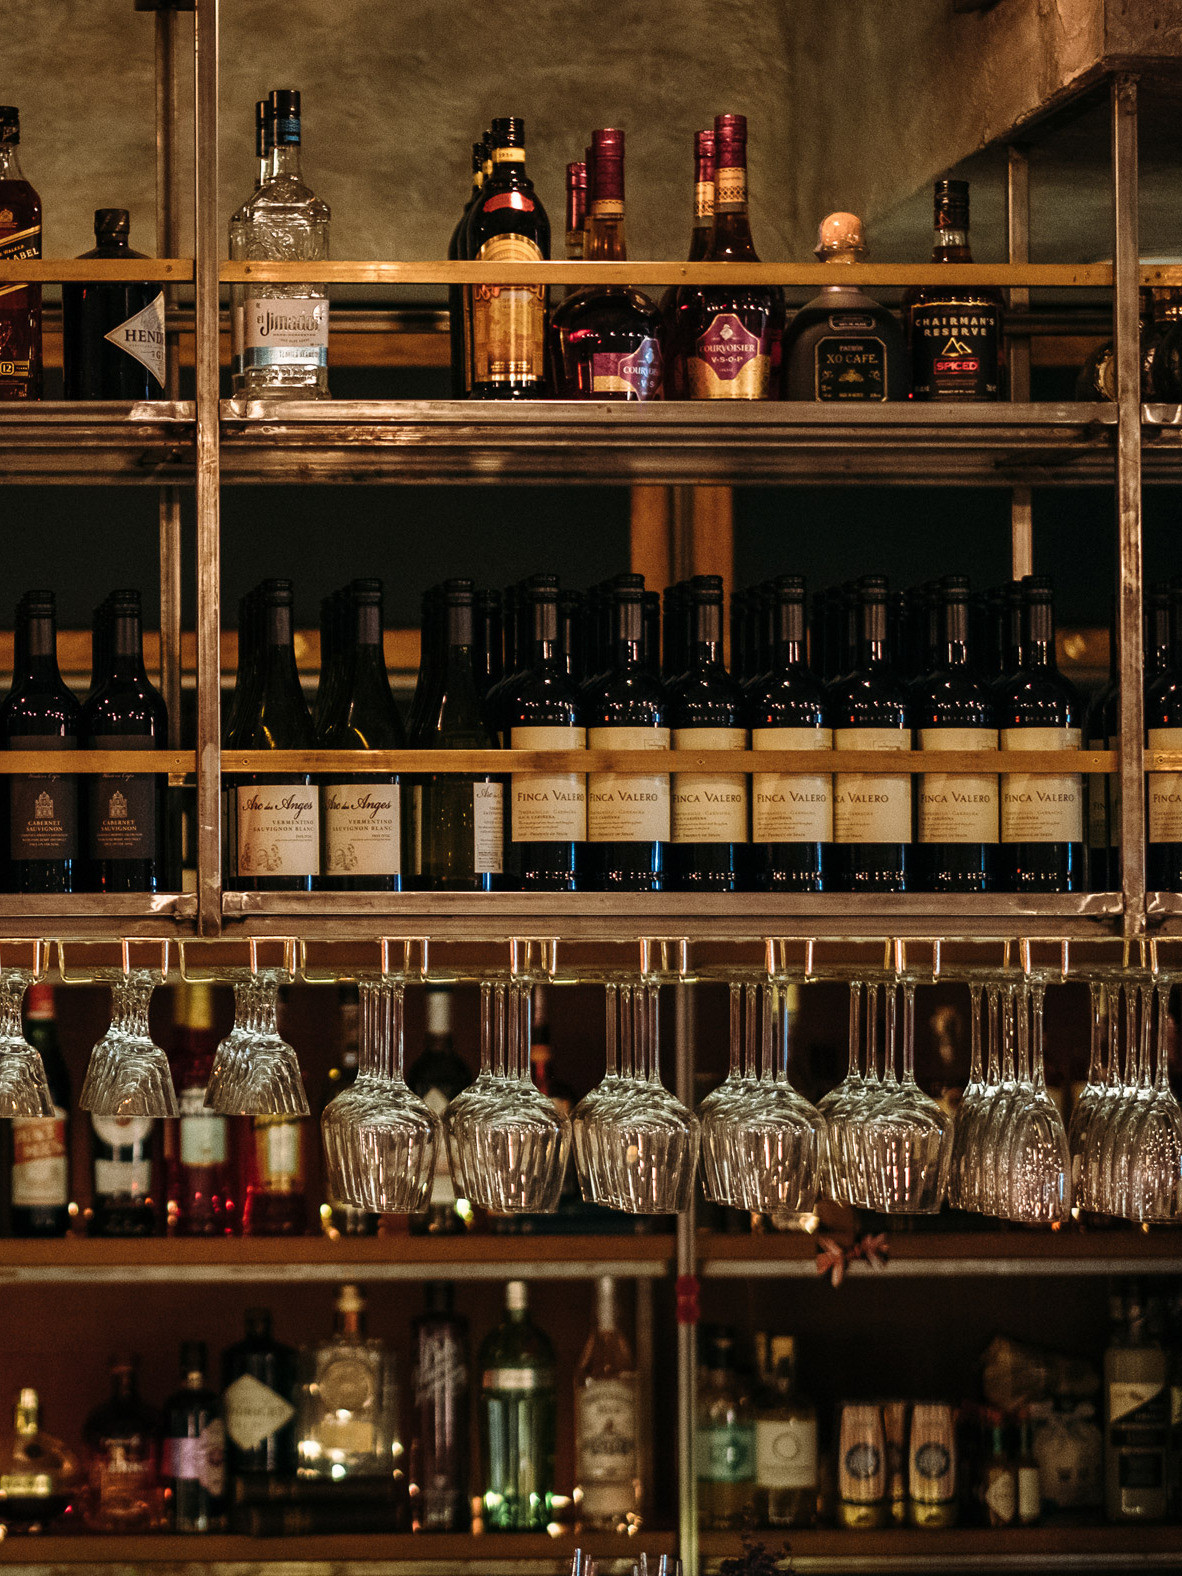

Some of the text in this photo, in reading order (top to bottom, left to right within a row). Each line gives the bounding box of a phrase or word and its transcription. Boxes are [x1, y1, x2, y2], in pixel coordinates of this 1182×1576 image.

[3, 245, 24, 254] WALKER
[257, 311, 320, 336] el Jimador
[915, 317, 995, 327] CHAIRMAN'S
[125, 330, 163, 345] HEND
[924, 328, 987, 337] RESERVE
[699, 344, 755, 355] COURVOISIER
[827, 354, 843, 364] XO
[3, 364, 12, 372] 12
[936, 361, 978, 371] SPICED
[518, 790, 584, 802] FINCA VALERO
[618, 790, 659, 802] VALERO
[704, 791, 742, 803] VALERO
[757, 793, 786, 803] FINCA
[789, 791, 827, 803] VALERO
[848, 792, 889, 803] VALERO
[951, 791, 991, 803] VALERO
[1005, 791, 1075, 802] FINCA VALERO
[1153, 794, 1182, 803] FINCA
[242, 794, 264, 811] Arc
[275, 794, 313, 820] Anges
[351, 793, 392, 819] Anges
